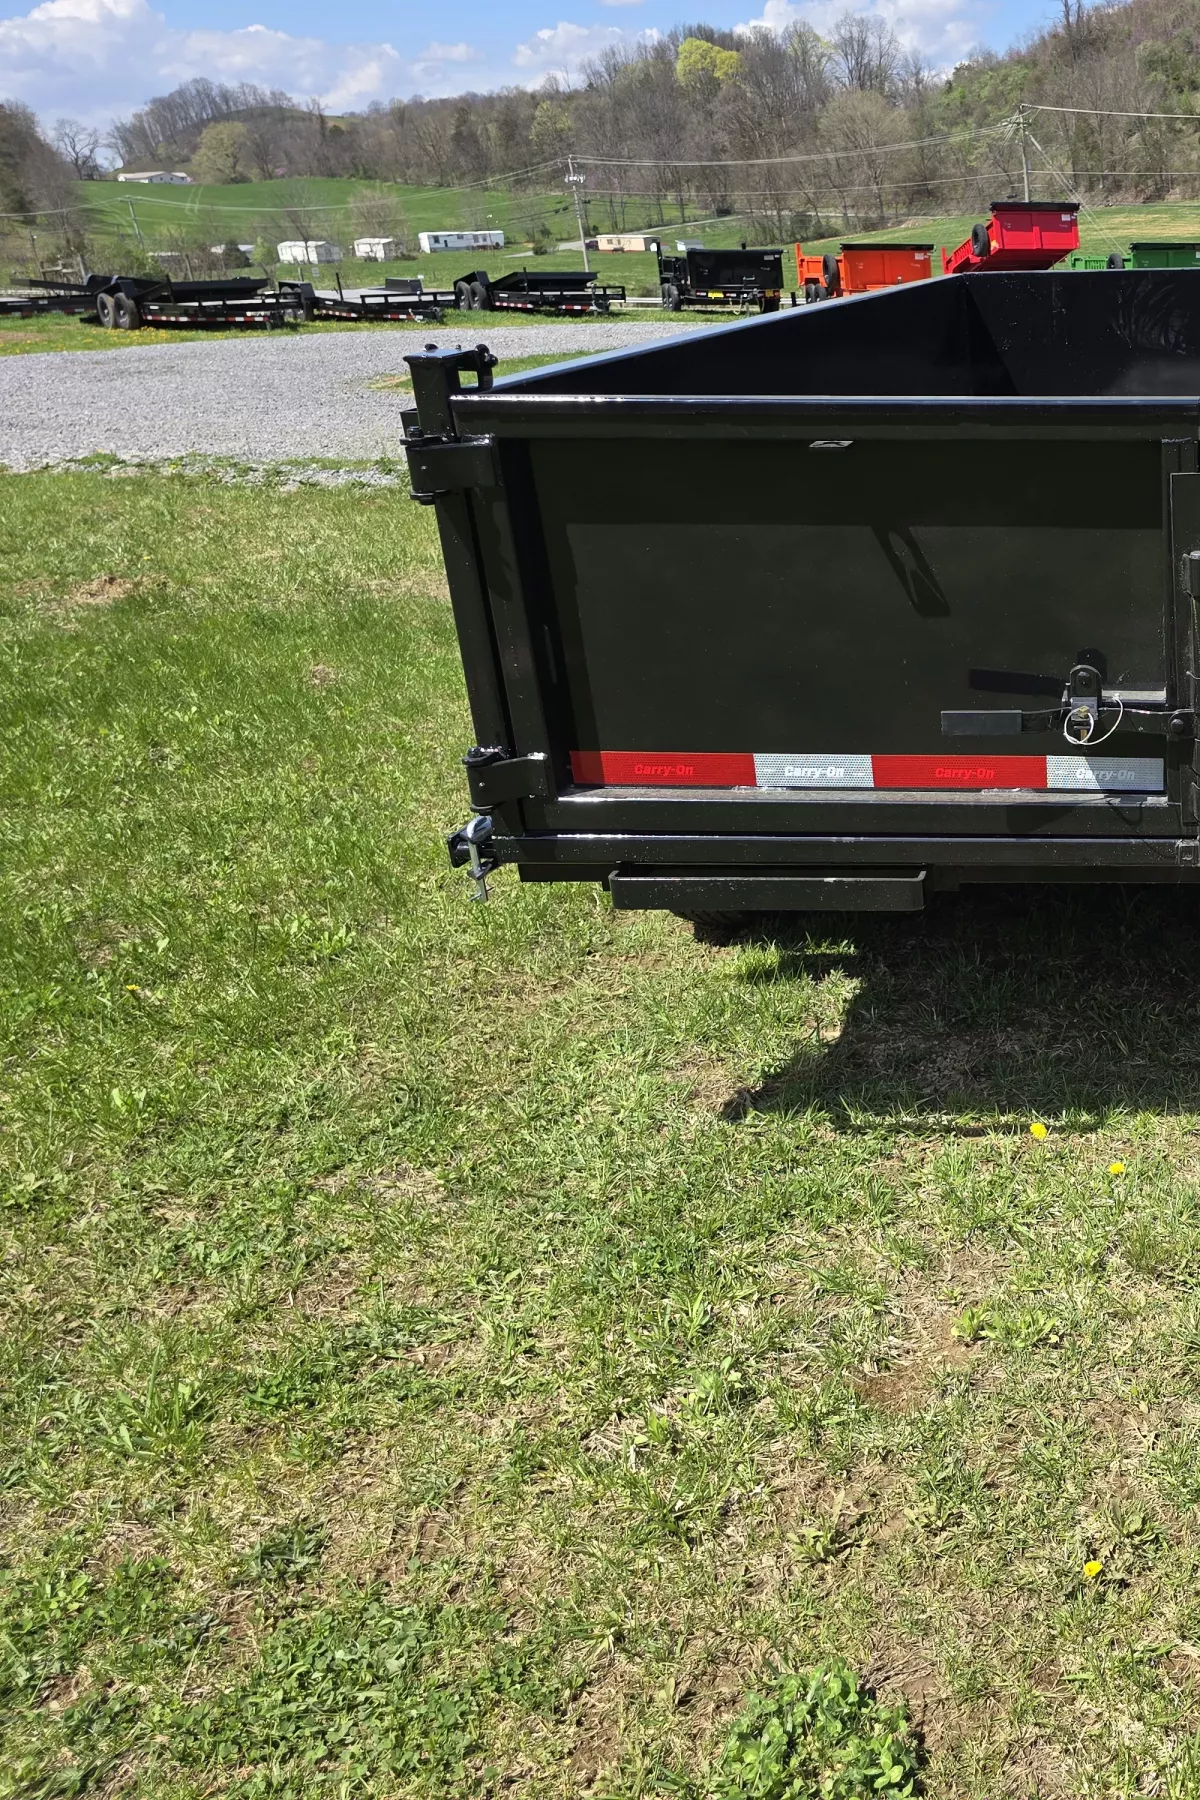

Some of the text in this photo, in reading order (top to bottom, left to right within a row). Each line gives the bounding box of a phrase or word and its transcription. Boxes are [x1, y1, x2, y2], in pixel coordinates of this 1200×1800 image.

[634, 764, 694, 776] Carry-On
[785, 766, 845, 779] Carry-On
[935, 768, 994, 780] Carry-On
